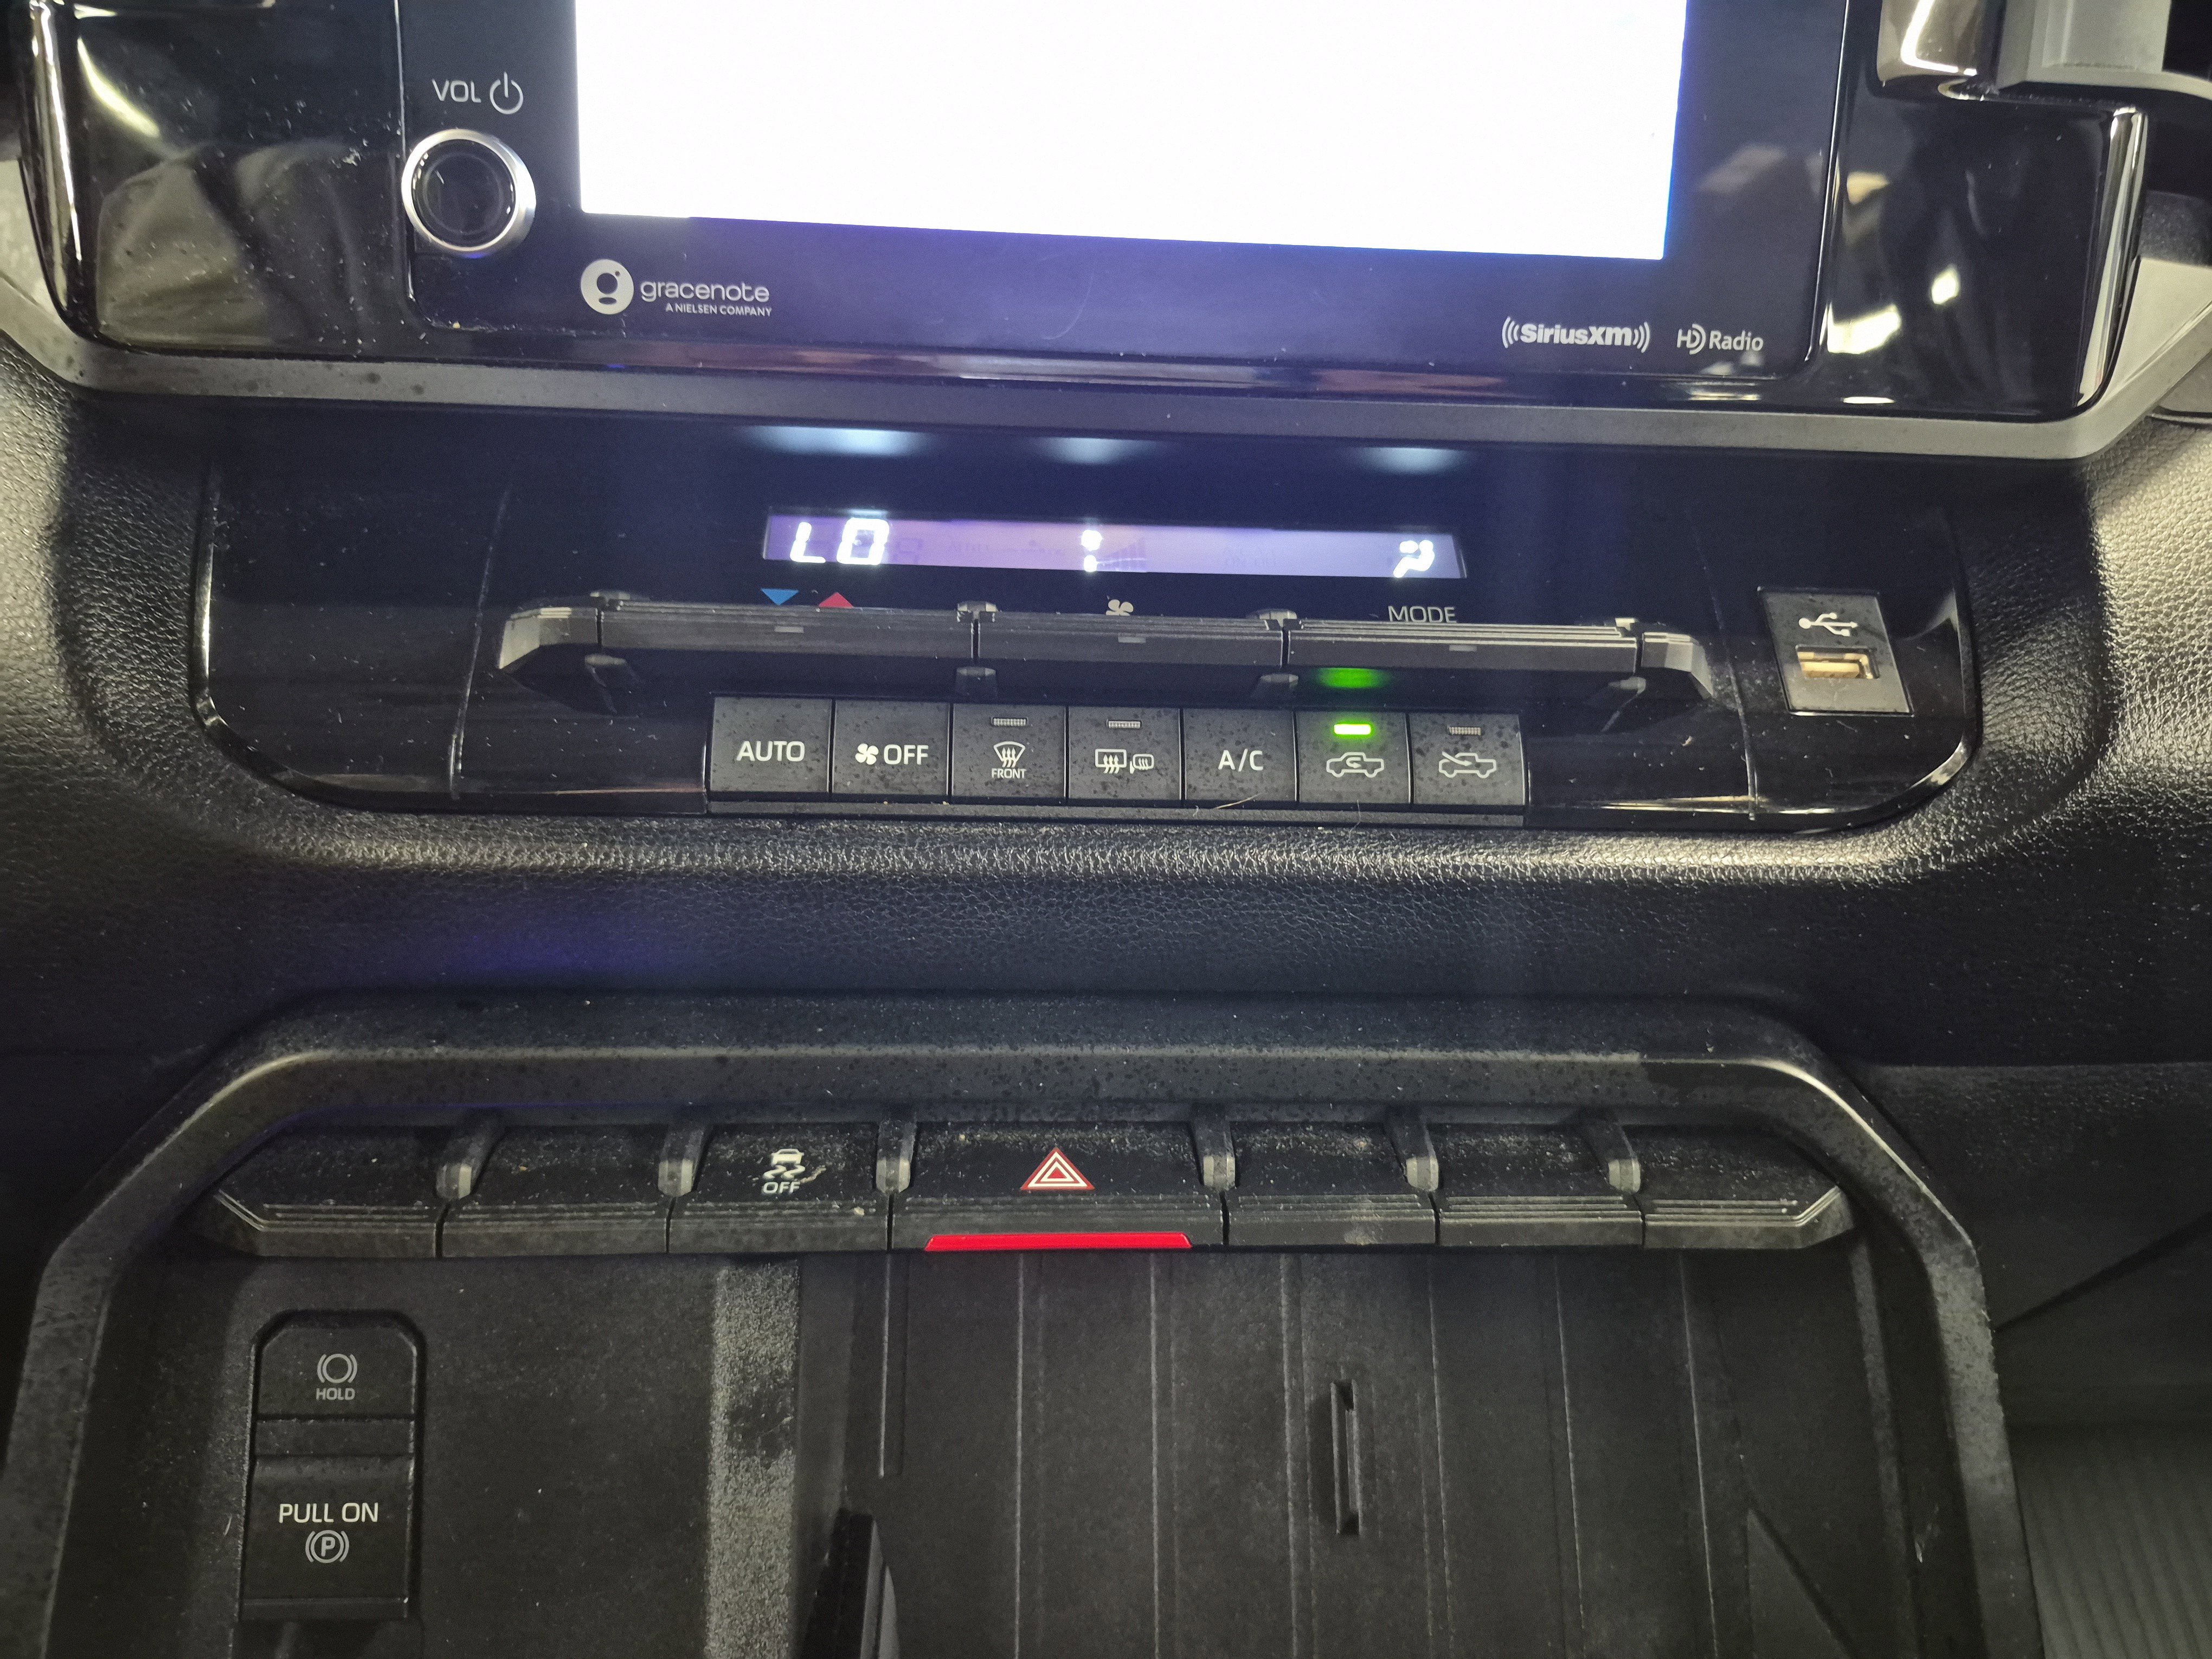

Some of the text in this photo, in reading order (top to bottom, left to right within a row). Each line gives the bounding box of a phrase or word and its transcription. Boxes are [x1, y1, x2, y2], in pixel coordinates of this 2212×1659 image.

[432, 79, 481, 103] VOL
[640, 281, 770, 303] gracenote
[666, 303, 772, 317] A NIELSEN COMPANY
[1709, 330, 1764, 352] Radio
[1388, 606, 1457, 623] MODE
[736, 741, 805, 762] AUTO
[884, 744, 929, 764] OFF
[1218, 749, 1264, 771] A/C
[991, 768, 1026, 779] FRONT
[762, 1181, 801, 1194] OFF
[316, 1388, 355, 1400] HOLD
[279, 1502, 378, 1523] PULL ON
[321, 1536, 336, 1557] P
